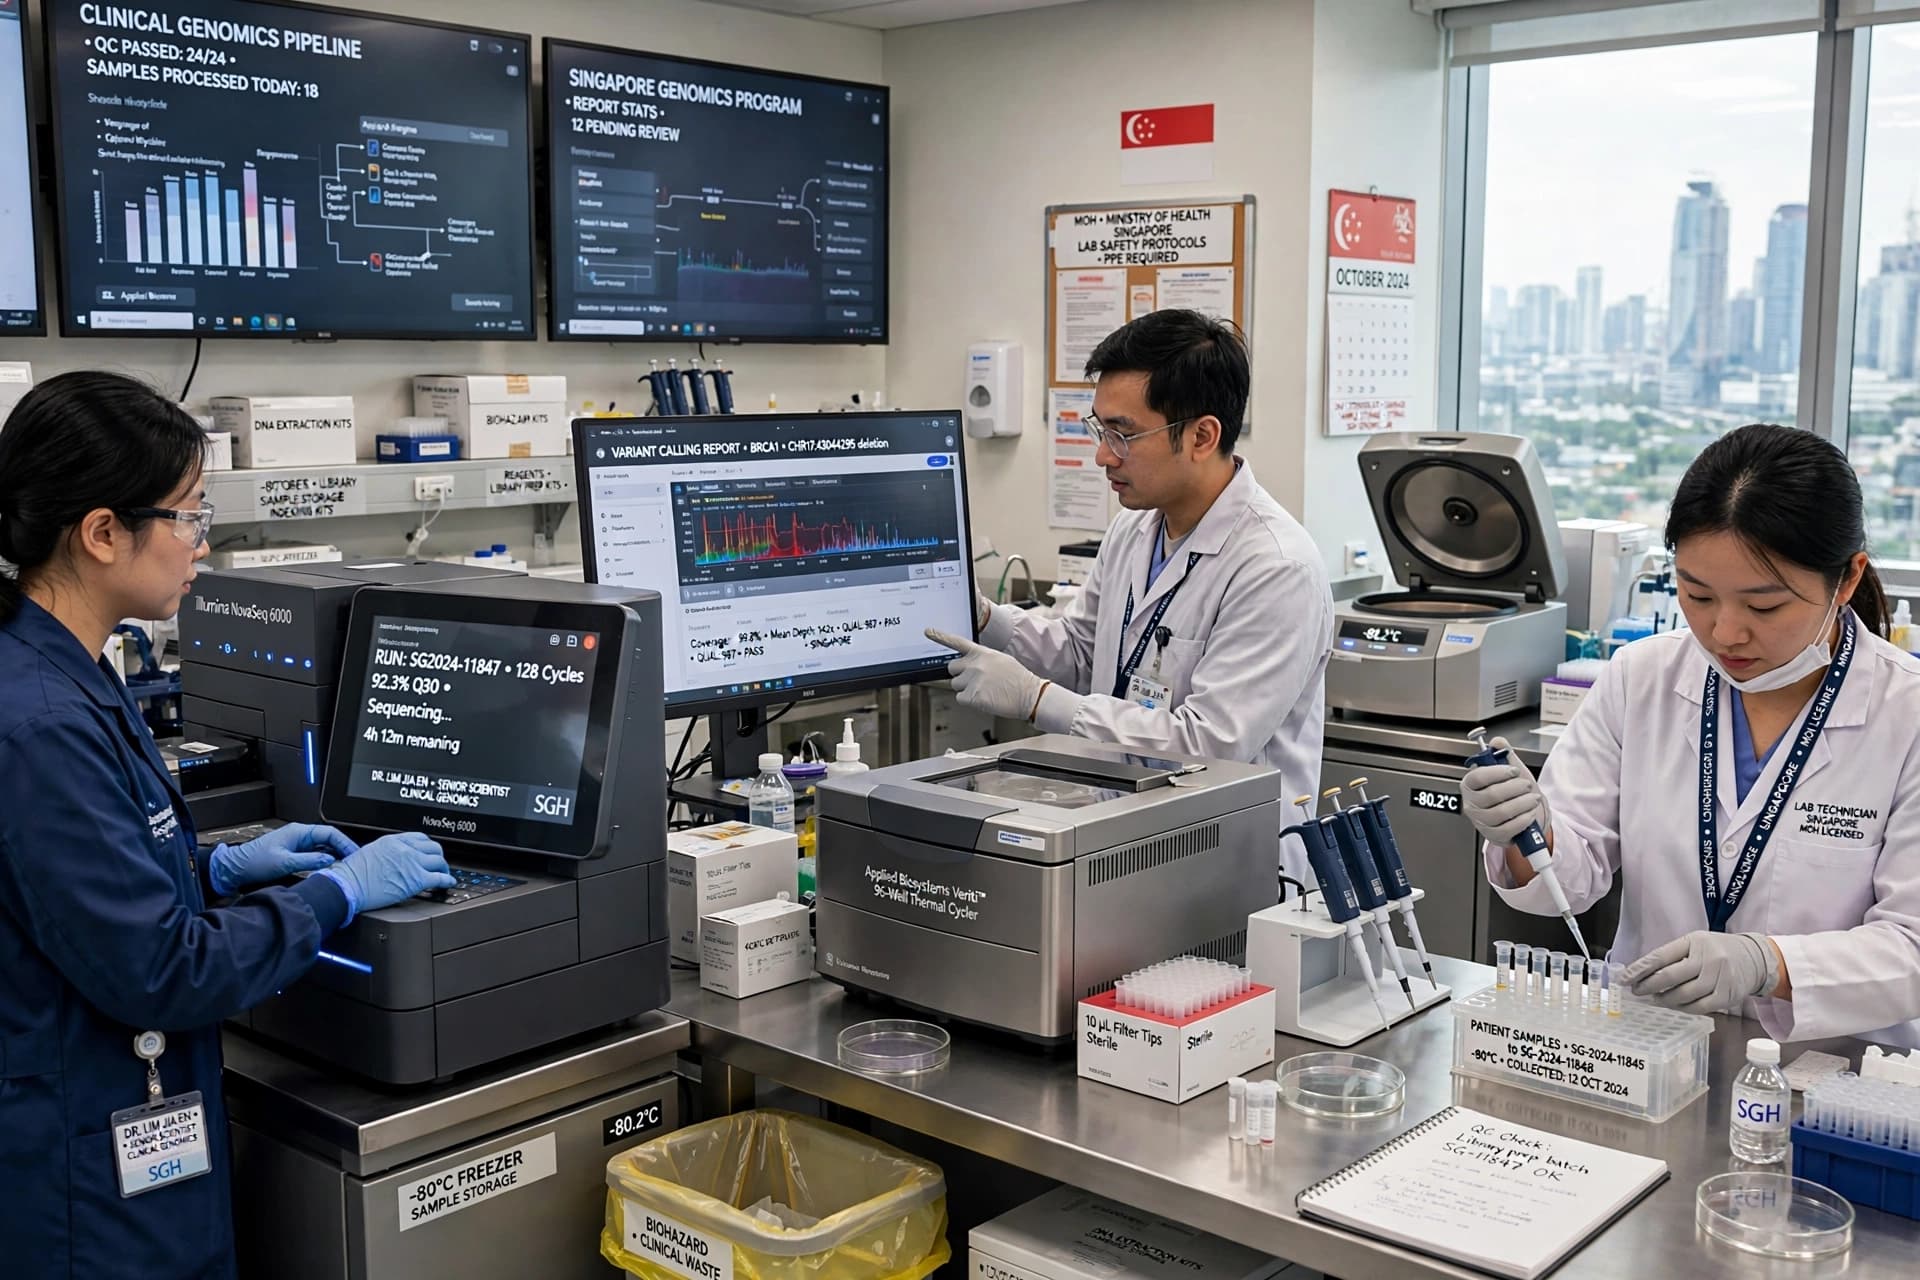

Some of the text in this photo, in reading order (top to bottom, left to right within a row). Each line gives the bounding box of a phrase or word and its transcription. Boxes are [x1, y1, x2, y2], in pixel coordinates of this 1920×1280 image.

[80, 3, 363, 59] CLINICAL GENOMICS PIPELINE
[94, 36, 226, 66] QC PASSED: 24/24
[86, 58, 319, 98] SAMPLES PROCESSED TODAY: 18
[568, 68, 802, 116] SINGAPORE GENOMICS PROGRAM
[573, 96, 658, 119] REPORT STATS
[572, 118, 680, 142] 12 PENDING REVIEW
[1074, 208, 1210, 226] MOH MINISTRY OF HEALTH
[1114, 224, 1172, 238] SINGAPORE
[1078, 236, 1206, 252] LAB SAFETY PROTOCOLS
[1104, 251, 1179, 266] PPE REQUIRED
[1336, 268, 1410, 290] OCTOBER 2024
[254, 418, 352, 430] DNA EXTRACTION KITS
[611, 444, 656, 458] VARIANT
[658, 443, 701, 458] CALLING
[703, 442, 741, 456] REPORT
[750, 441, 780, 454] BRCA1
[857, 437, 889, 450] deletion
[230, 602, 268, 625] NovaSeq
[269, 608, 292, 624] 6000
[770, 628, 792, 640] Mean
[884, 616, 901, 628] PASS
[744, 646, 764, 658] PASS
[374, 649, 585, 685] RUN: SG2024-11847 128 Cycles
[371, 673, 440, 696] 92.3% Q30
[366, 698, 452, 724] Sequencing...
[364, 727, 378, 742] 4h
[380, 728, 404, 745] 12m
[372, 770, 385, 782] DR.
[386, 772, 400, 784] LIM
[437, 778, 467, 793] SENIOR
[468, 782, 511, 798] SCIENTIST
[400, 788, 480, 808] CLINICAL GENOMICS
[533, 794, 570, 817] SGH
[1413, 791, 1458, 810] -80.2°C
[1794, 802, 1878, 819] LAB TECHNICIAN
[1806, 814, 1859, 829] SINGAPORE
[456, 818, 477, 833] 6000
[1800, 824, 1820, 834] MOH
[864, 864, 898, 884] Applied
[910, 892, 946, 914] Thermal
[948, 902, 979, 920] Cycler
[1085, 1014, 1096, 1028] 10
[1114, 1022, 1140, 1040] Filter
[1142, 1028, 1162, 1048] Tips
[1086, 1032, 1118, 1051] Sterile
[1187, 1030, 1214, 1050] Sterile
[1470, 1019, 1646, 1070] PATIENT SAMPLES SG-2024-11845
[1508, 1043, 1594, 1073] to SG-2024-11848
[1568, 1074, 1578, 1085] 12
[1580, 1076, 1602, 1091] OCT
[1604, 1080, 1629, 1096] 2024
[608, 1106, 659, 1137] -80.2°C
[1738, 1098, 1780, 1123] SGH
[124, 1111, 192, 1139] DR. LIM JIA EN
[1471, 1124, 1496, 1136] QC
[1442, 1142, 1564, 1182] SG-11847 OK
[1456, 1132, 1505, 1155] Library
[1546, 1156, 1590, 1174] batch
[148, 1158, 182, 1182] SGH
[408, 1150, 524, 1202] -80°C FREEZER
[410, 1172, 518, 1222] SAMPLE STORAGE
[646, 1216, 709, 1256] BIOHAZARD
[640, 1233, 721, 1280] CLINICAL WASTE
